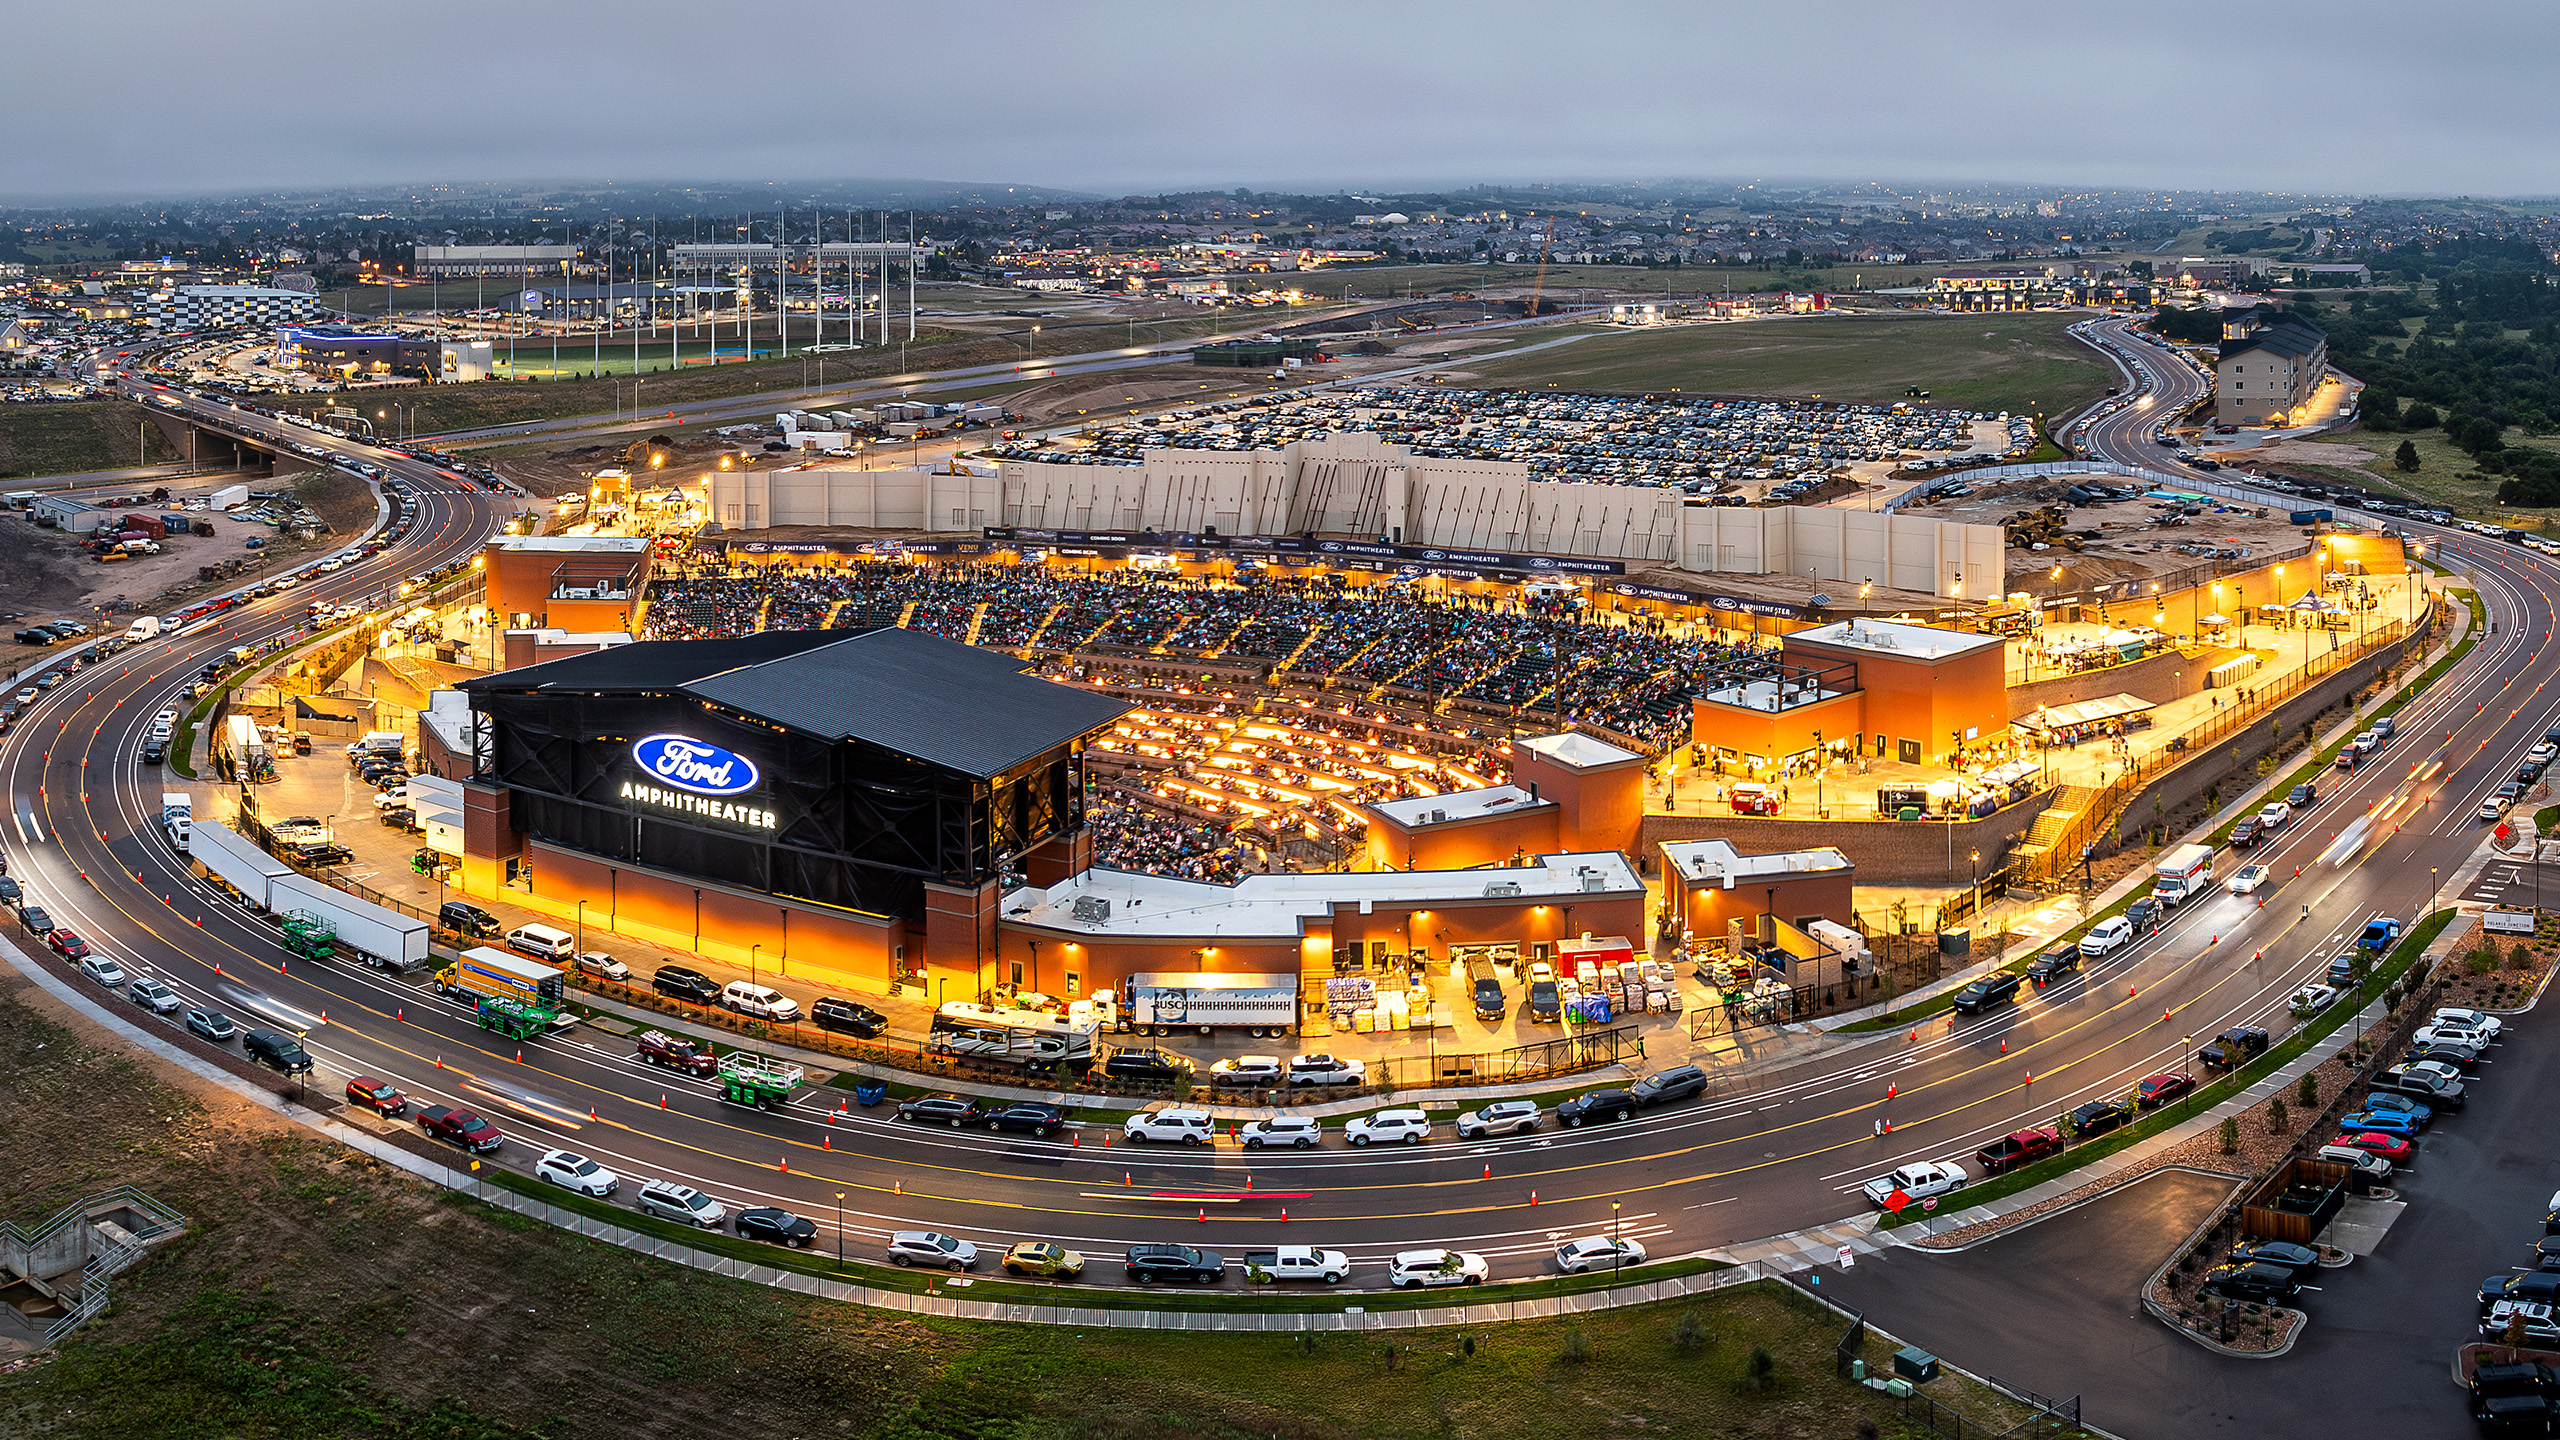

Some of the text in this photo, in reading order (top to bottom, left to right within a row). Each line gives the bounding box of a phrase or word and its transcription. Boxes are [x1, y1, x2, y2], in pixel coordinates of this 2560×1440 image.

[957, 543, 979, 551] VENU
[1346, 545, 1395, 555] AMPHITHEATER
[1285, 556, 1307, 564] VENU
[1448, 554, 1500, 563] AMPHITHEATER
[1557, 561, 1611, 571] AMPHITHEATER
[1426, 568, 1479, 578] AMPHITHEATER
[1639, 588, 1688, 601] AMPHITHEATER
[620, 781, 777, 830] AMPHITHEATER
